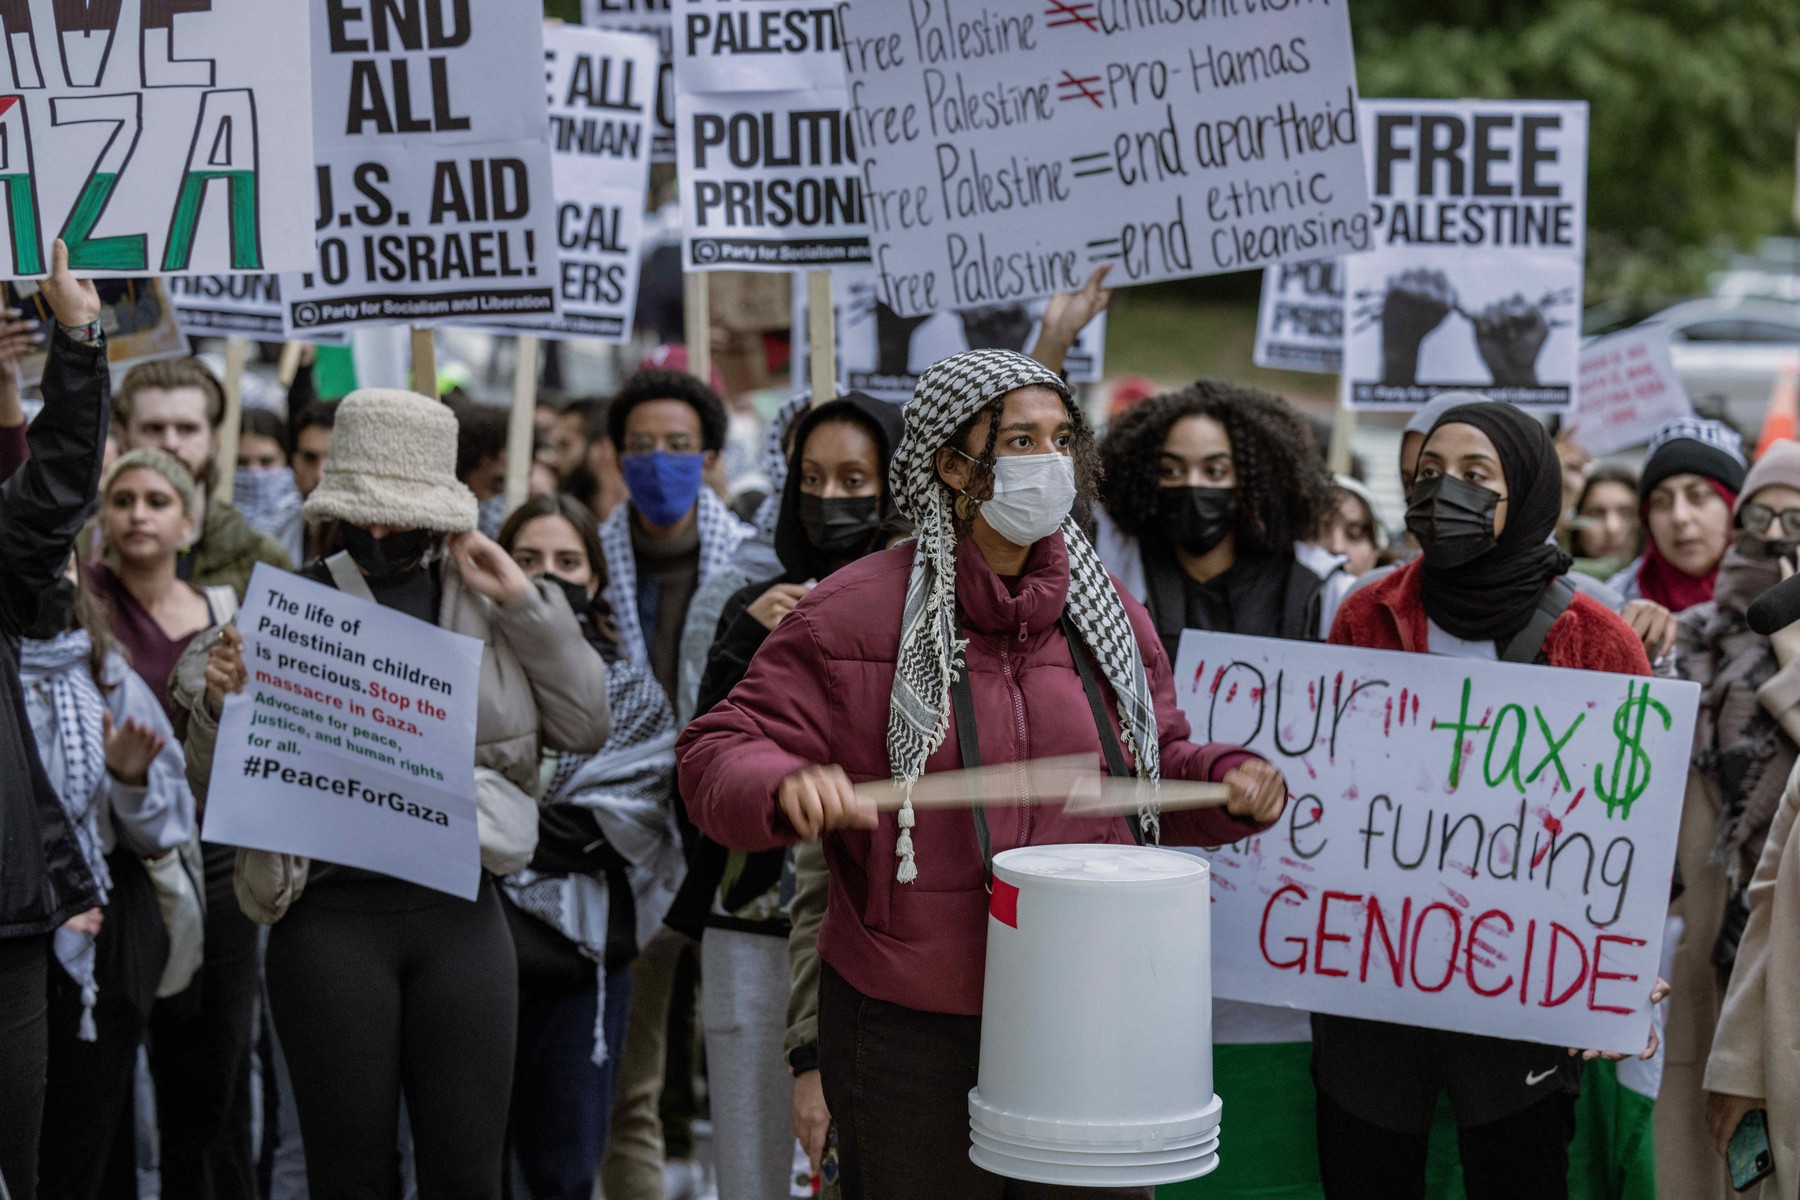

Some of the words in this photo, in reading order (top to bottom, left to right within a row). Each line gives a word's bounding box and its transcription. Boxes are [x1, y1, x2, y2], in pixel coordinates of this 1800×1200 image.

[327, 0, 471, 54] END
[909, 0, 1037, 63] Palestine
[346, 56, 470, 135] ALL
[566, 54, 643, 112] ALL
[851, 80, 920, 148] free
[923, 69, 1055, 136] Palestine
[862, 158, 933, 233] free
[936, 143, 1070, 221] Palestine
[1114, 103, 1189, 186] end
[1196, 86, 1357, 169] apartheid
[1376, 114, 1563, 197] FREE
[429, 158, 530, 225] AID
[1207, 170, 1333, 222] ethnic
[303, 237, 348, 287] O
[363, 229, 538, 282] ISRAEL!
[557, 203, 628, 253] CAL
[878, 243, 939, 313] free
[947, 231, 1081, 305] Palestine
[1122, 195, 1193, 280] end
[322, 303, 356, 321] Party
[361, 300, 382, 316] for
[383, 299, 449, 315] Socialism
[451, 297, 477, 312] and
[480, 294, 550, 310] Liberation
[560, 261, 627, 304] ERS
[267, 589, 300, 616] The
[304, 602, 335, 628] life
[341, 619, 362, 637] of
[256, 642, 272, 661] is
[417, 698, 447, 721] the
[258, 615, 366, 666] Palestinian
[372, 655, 453, 696] children
[254, 691, 324, 723] Advocate
[327, 714, 349, 732] for
[353, 721, 403, 753] peace,
[256, 669, 344, 709] massacre
[349, 699, 366, 717] in
[372, 706, 424, 737] Gaza.
[247, 733, 272, 750] for
[276, 738, 302, 756] all.
[250, 711, 311, 739] justice,
[315, 729, 342, 749] and
[346, 740, 396, 765] human
[399, 758, 445, 782] rights
[243, 755, 450, 827] #PeaceForGaza
[1359, 794, 1635, 927] funding
